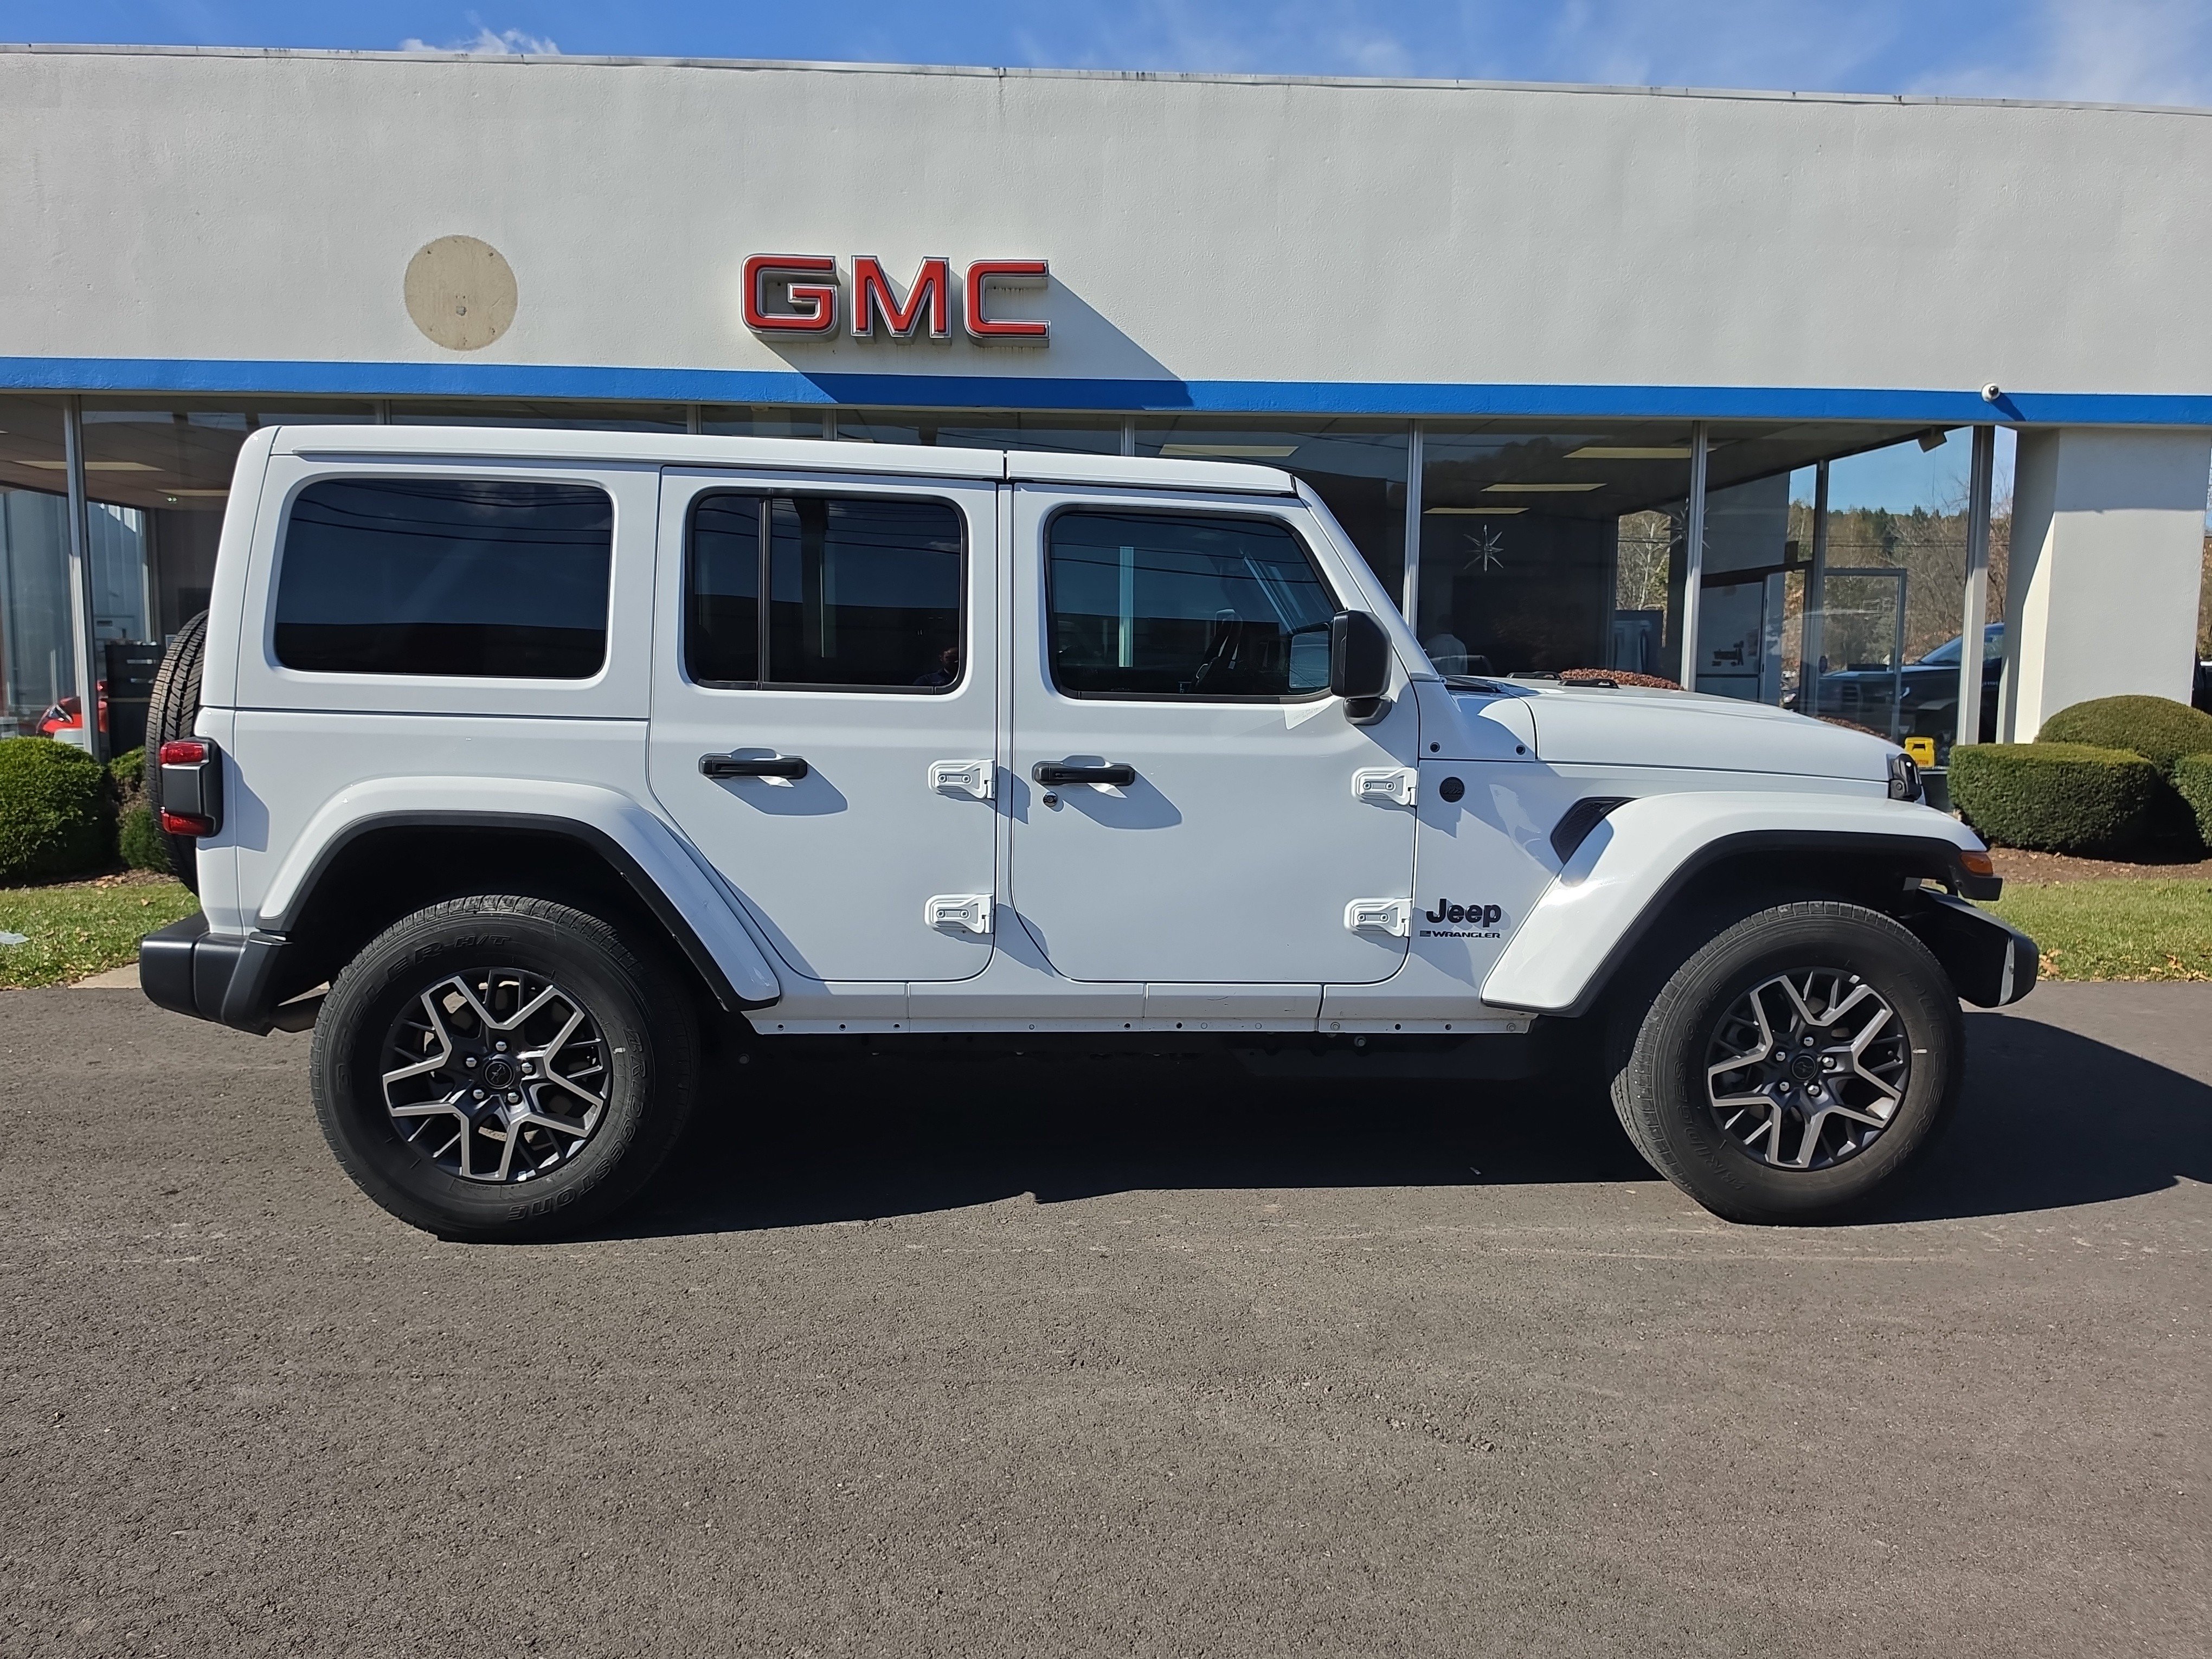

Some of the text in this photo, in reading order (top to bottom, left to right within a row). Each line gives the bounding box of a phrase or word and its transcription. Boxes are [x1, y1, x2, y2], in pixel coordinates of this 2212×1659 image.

[741, 253, 1050, 338] GMC
[1426, 898, 1502, 928] Jeep
[1432, 930, 1501, 939] WRANGLER
[507, 1027, 647, 1221] BRIDGESTONE
